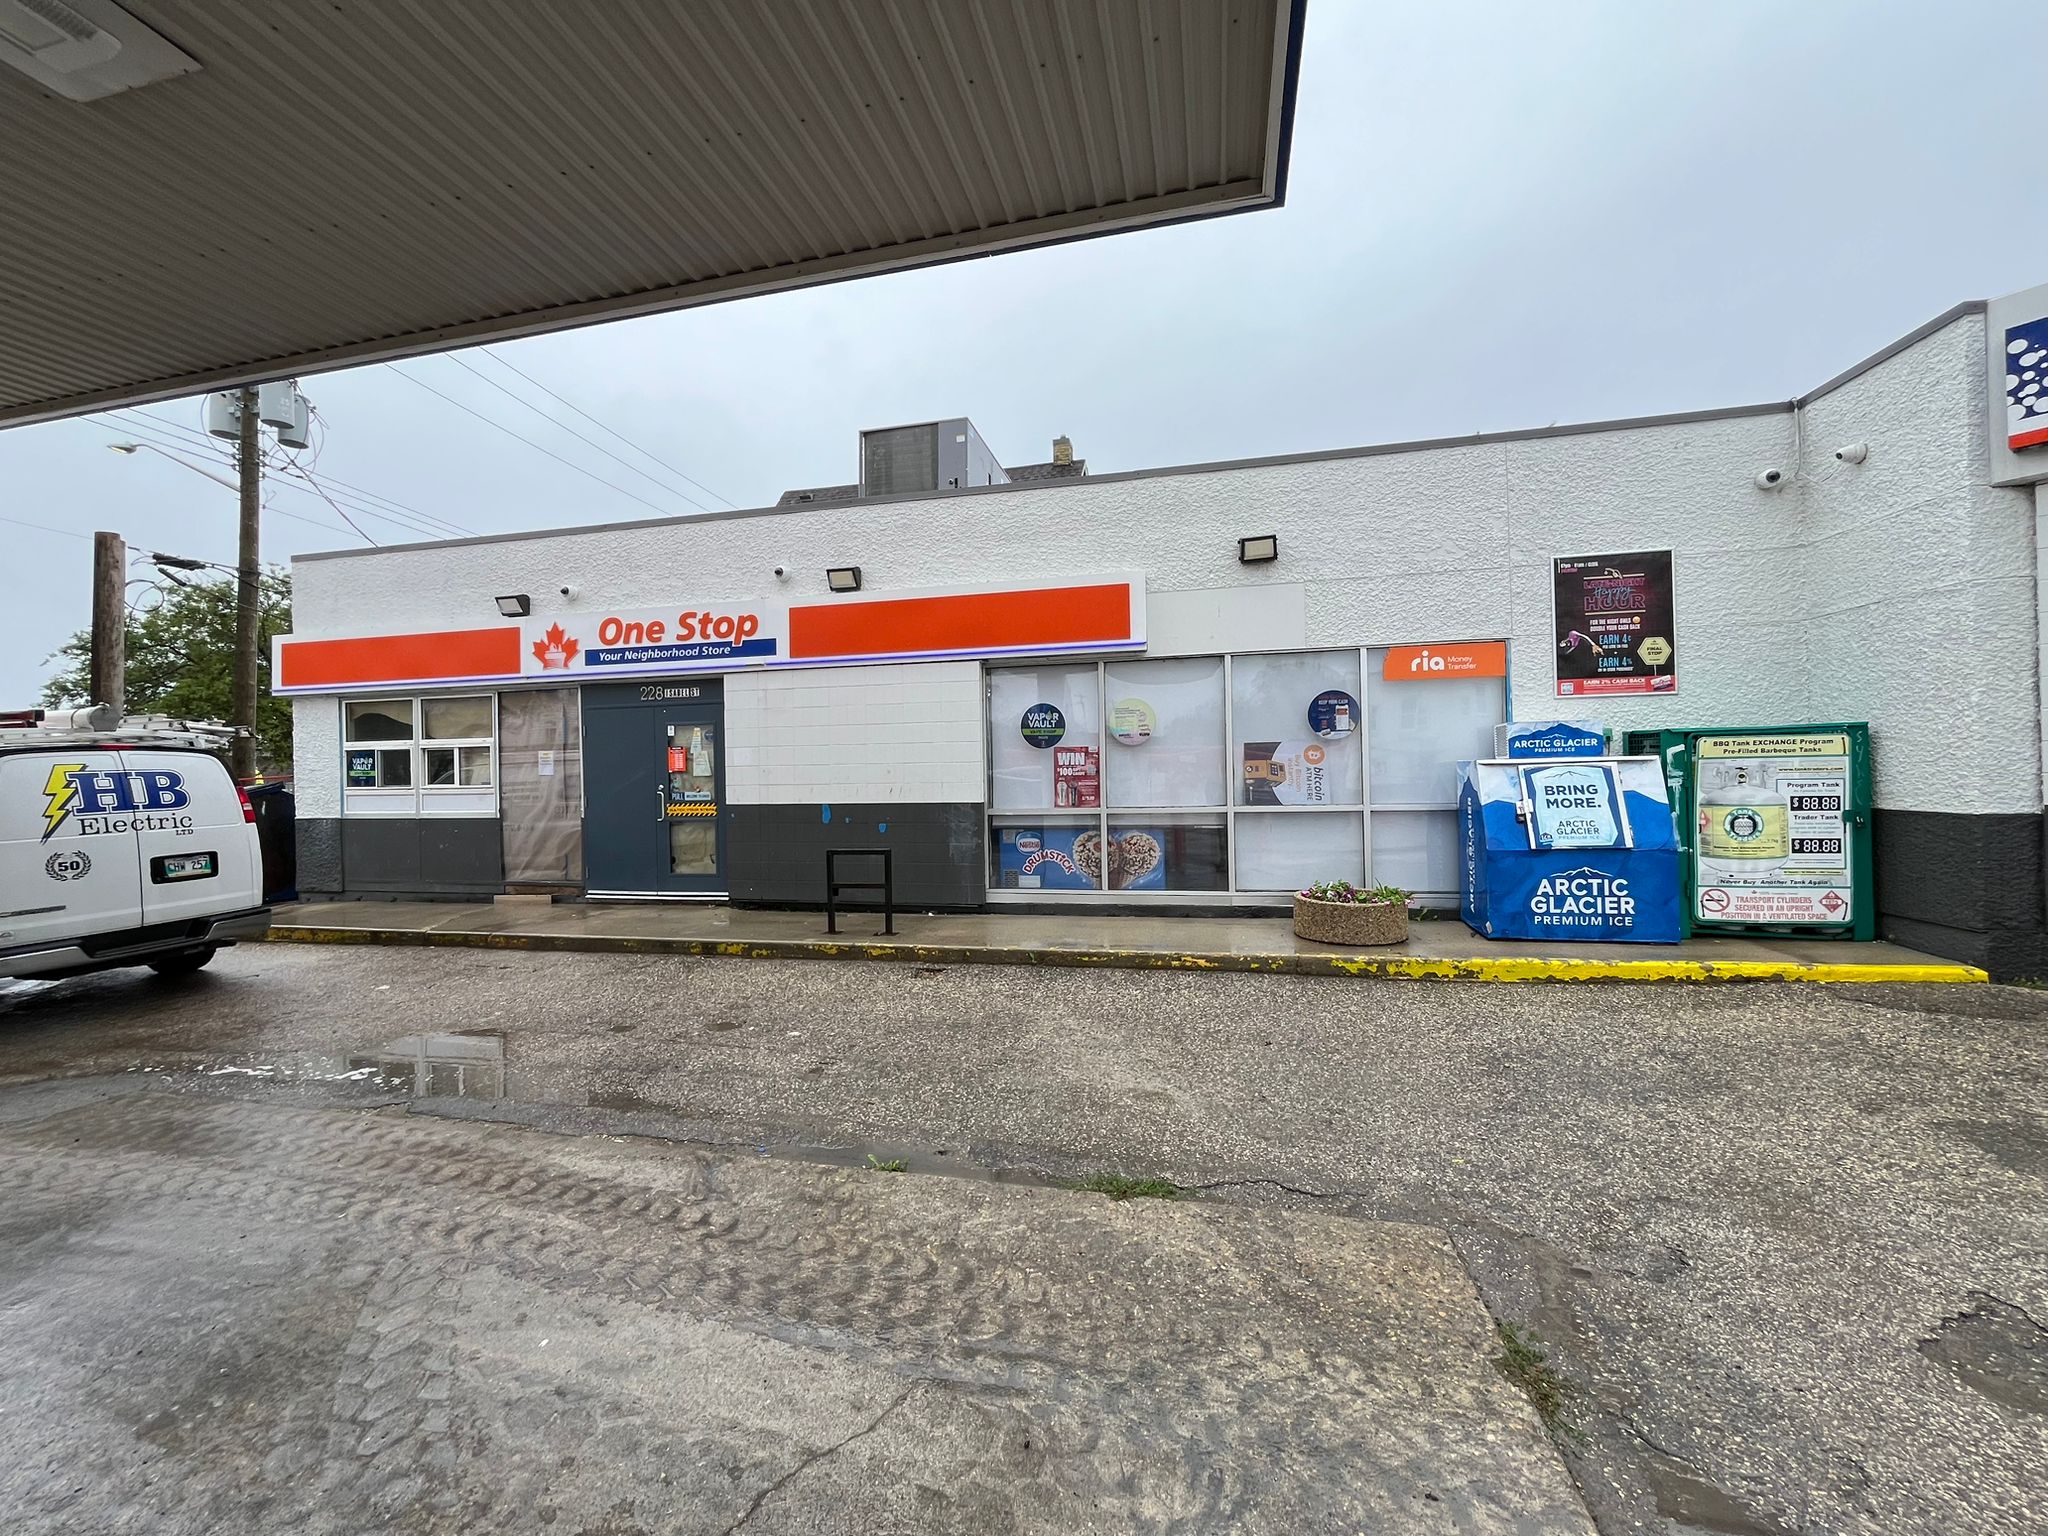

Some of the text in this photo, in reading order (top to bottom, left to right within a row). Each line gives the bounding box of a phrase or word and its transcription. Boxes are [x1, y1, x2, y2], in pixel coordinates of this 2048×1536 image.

[1593, 586, 1636, 605] Happy
[1584, 594, 1646, 610] HOUR
[598, 612, 758, 646] One Stop
[1599, 634, 1620, 644] EARN
[599, 646, 730, 661] Your Neighborhood Store
[1411, 650, 1444, 671] ria
[1598, 657, 1619, 668] EARN
[640, 686, 700, 700] 228 ISABEL ST
[1028, 710, 1059, 720] VAPOR
[1028, 720, 1056, 728] VAULT
[1514, 738, 1598, 748] ARCTIC GLACIER
[1799, 738, 1834, 746] Program
[1057, 752, 1085, 766] WIN
[1057, 767, 1073, 776] $100
[1314, 766, 1324, 801] bitcoin
[65, 770, 191, 816] HB
[1306, 784, 1314, 800] HERE
[1544, 784, 1598, 796] BRING
[1546, 798, 1602, 808] MORE.
[1802, 797, 1839, 810] 88.88
[76, 812, 192, 836] Electric
[1558, 820, 1596, 828] ARCTIC
[1556, 828, 1600, 836] GLACIER
[1803, 840, 1839, 852] 88.88
[58, 861, 80, 871] 50
[191, 860, 209, 870] 257
[1022, 848, 1076, 874] DRUMSTICK
[1536, 878, 1628, 896] ARCTIC
[1530, 896, 1636, 914] GLACIER
[1736, 896, 1812, 904] TRANSPORT CYLINDERS
[1534, 916, 1633, 926] PREMIUM ICE
